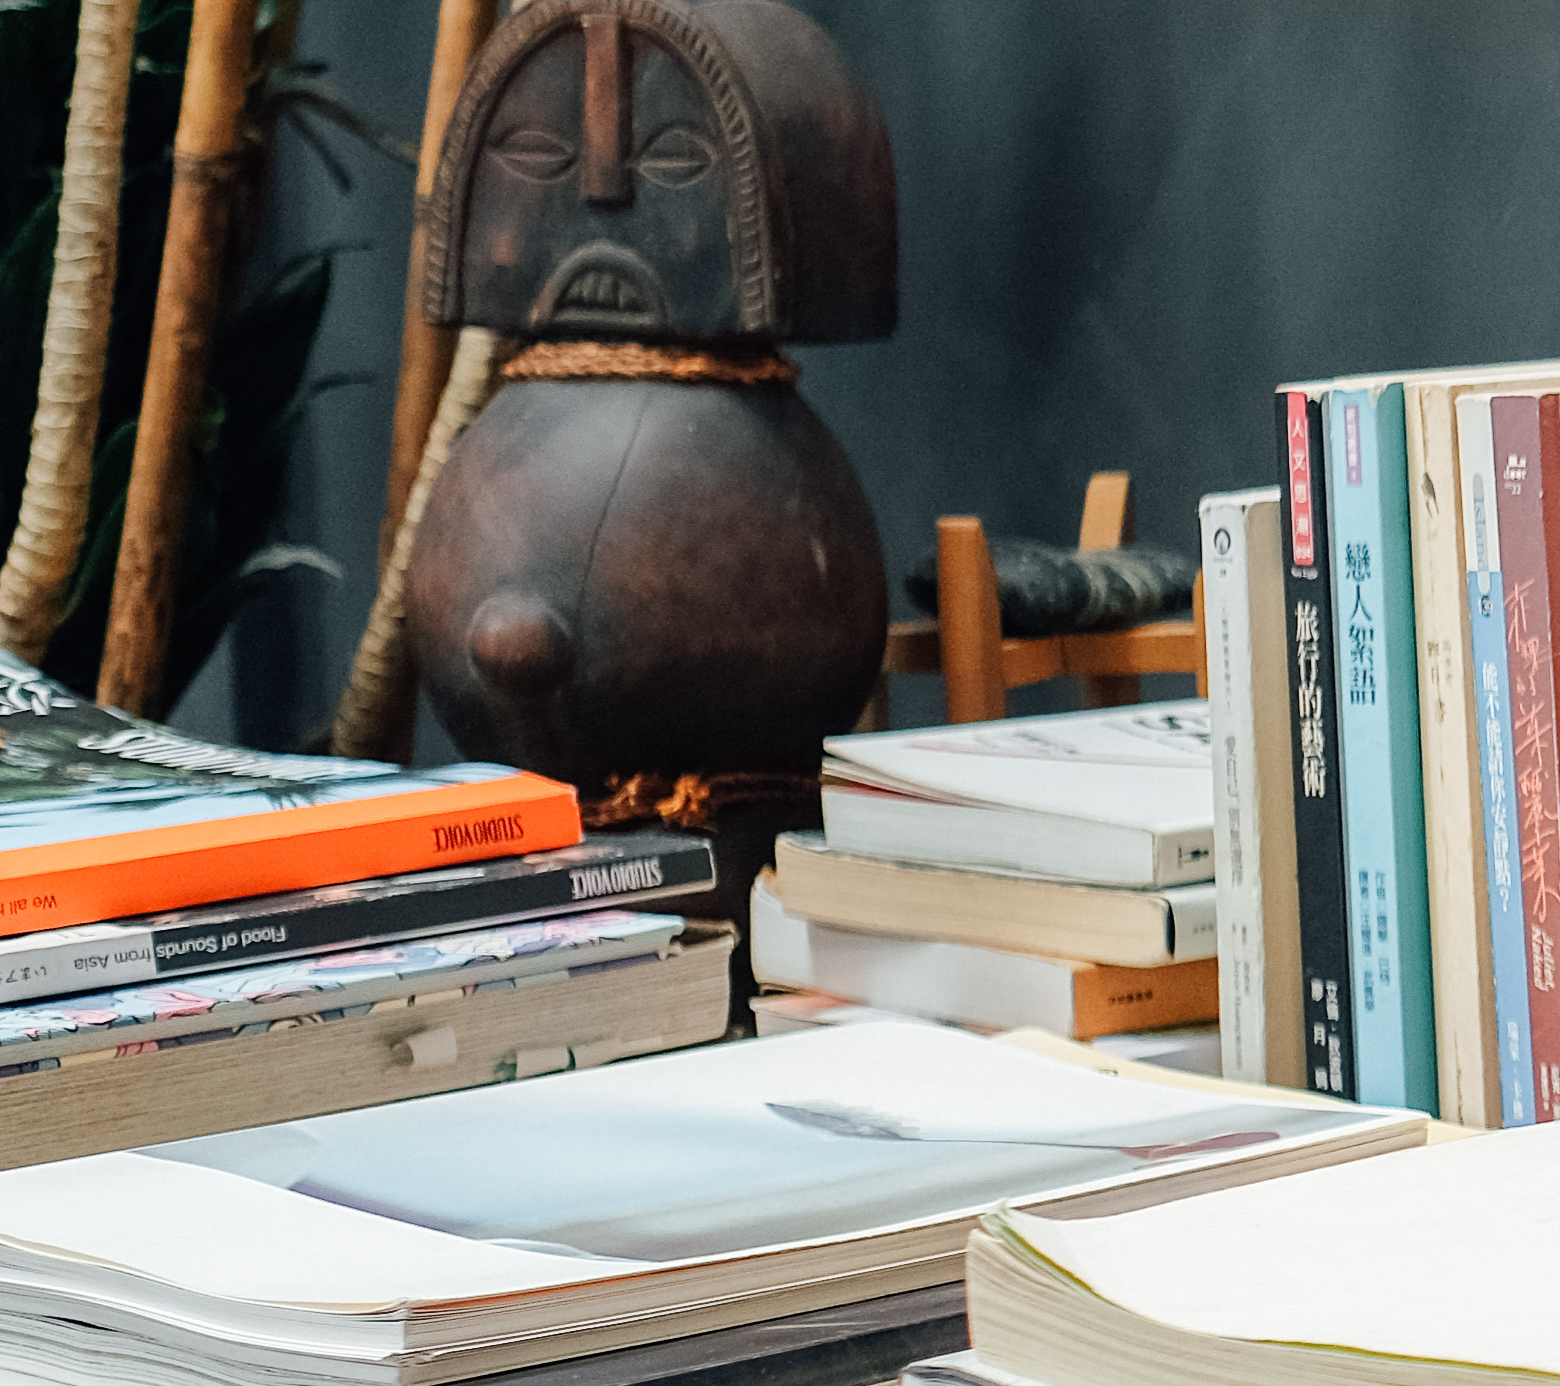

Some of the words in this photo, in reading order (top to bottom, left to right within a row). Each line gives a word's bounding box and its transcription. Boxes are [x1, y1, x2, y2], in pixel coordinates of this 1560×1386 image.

[1344, 542, 1377, 707] 戀人絮語
[30, 893, 58, 913] We
[155, 933, 219, 963] Sounds
[220, 932, 237, 951] of
[241, 925, 287, 948] Flood
[73, 953, 111, 976] Asia
[113, 946, 153, 966] from
